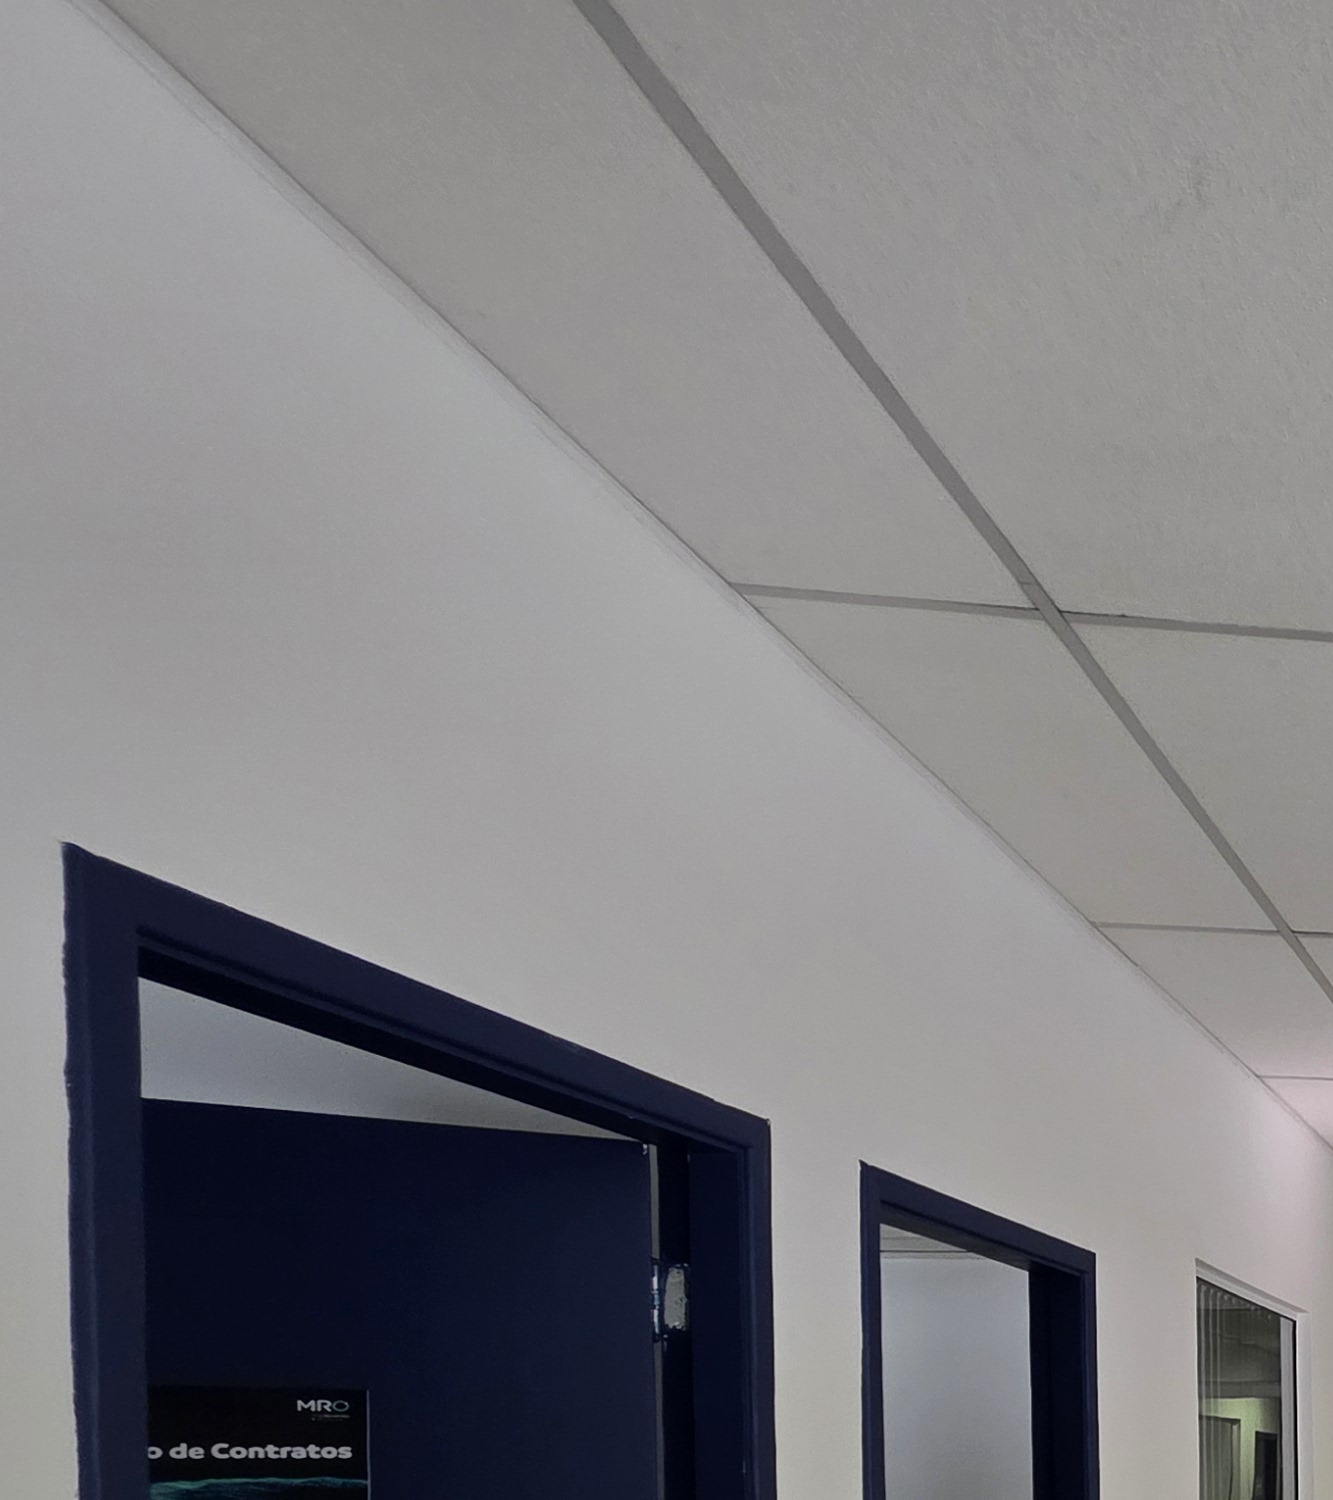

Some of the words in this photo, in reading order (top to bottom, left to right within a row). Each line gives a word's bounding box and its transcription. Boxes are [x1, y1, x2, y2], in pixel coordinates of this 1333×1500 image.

[297, 1399, 350, 1412] MRO
[169, 1442, 205, 1460] de
[211, 1443, 353, 1460] Contratos
